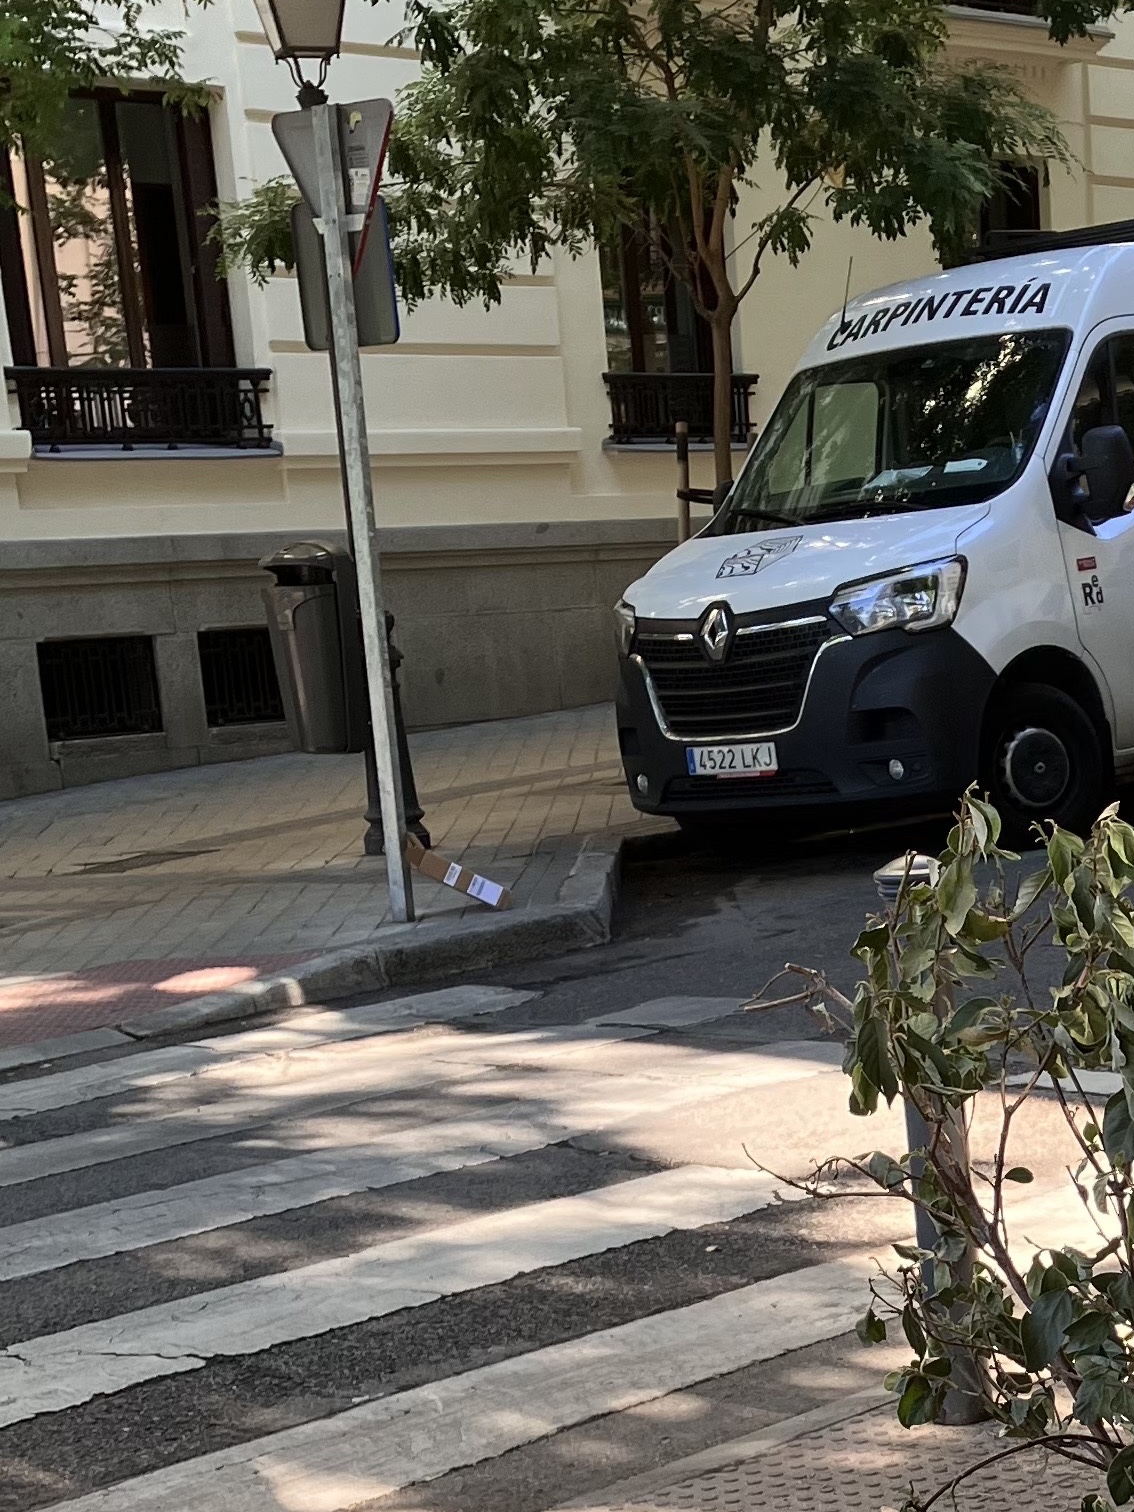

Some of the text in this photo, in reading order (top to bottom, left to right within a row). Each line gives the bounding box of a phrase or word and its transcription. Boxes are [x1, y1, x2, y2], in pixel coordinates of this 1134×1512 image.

[826, 277, 1051, 351] CARPINTERÍA
[699, 745, 773, 770] 4522 LKJ
